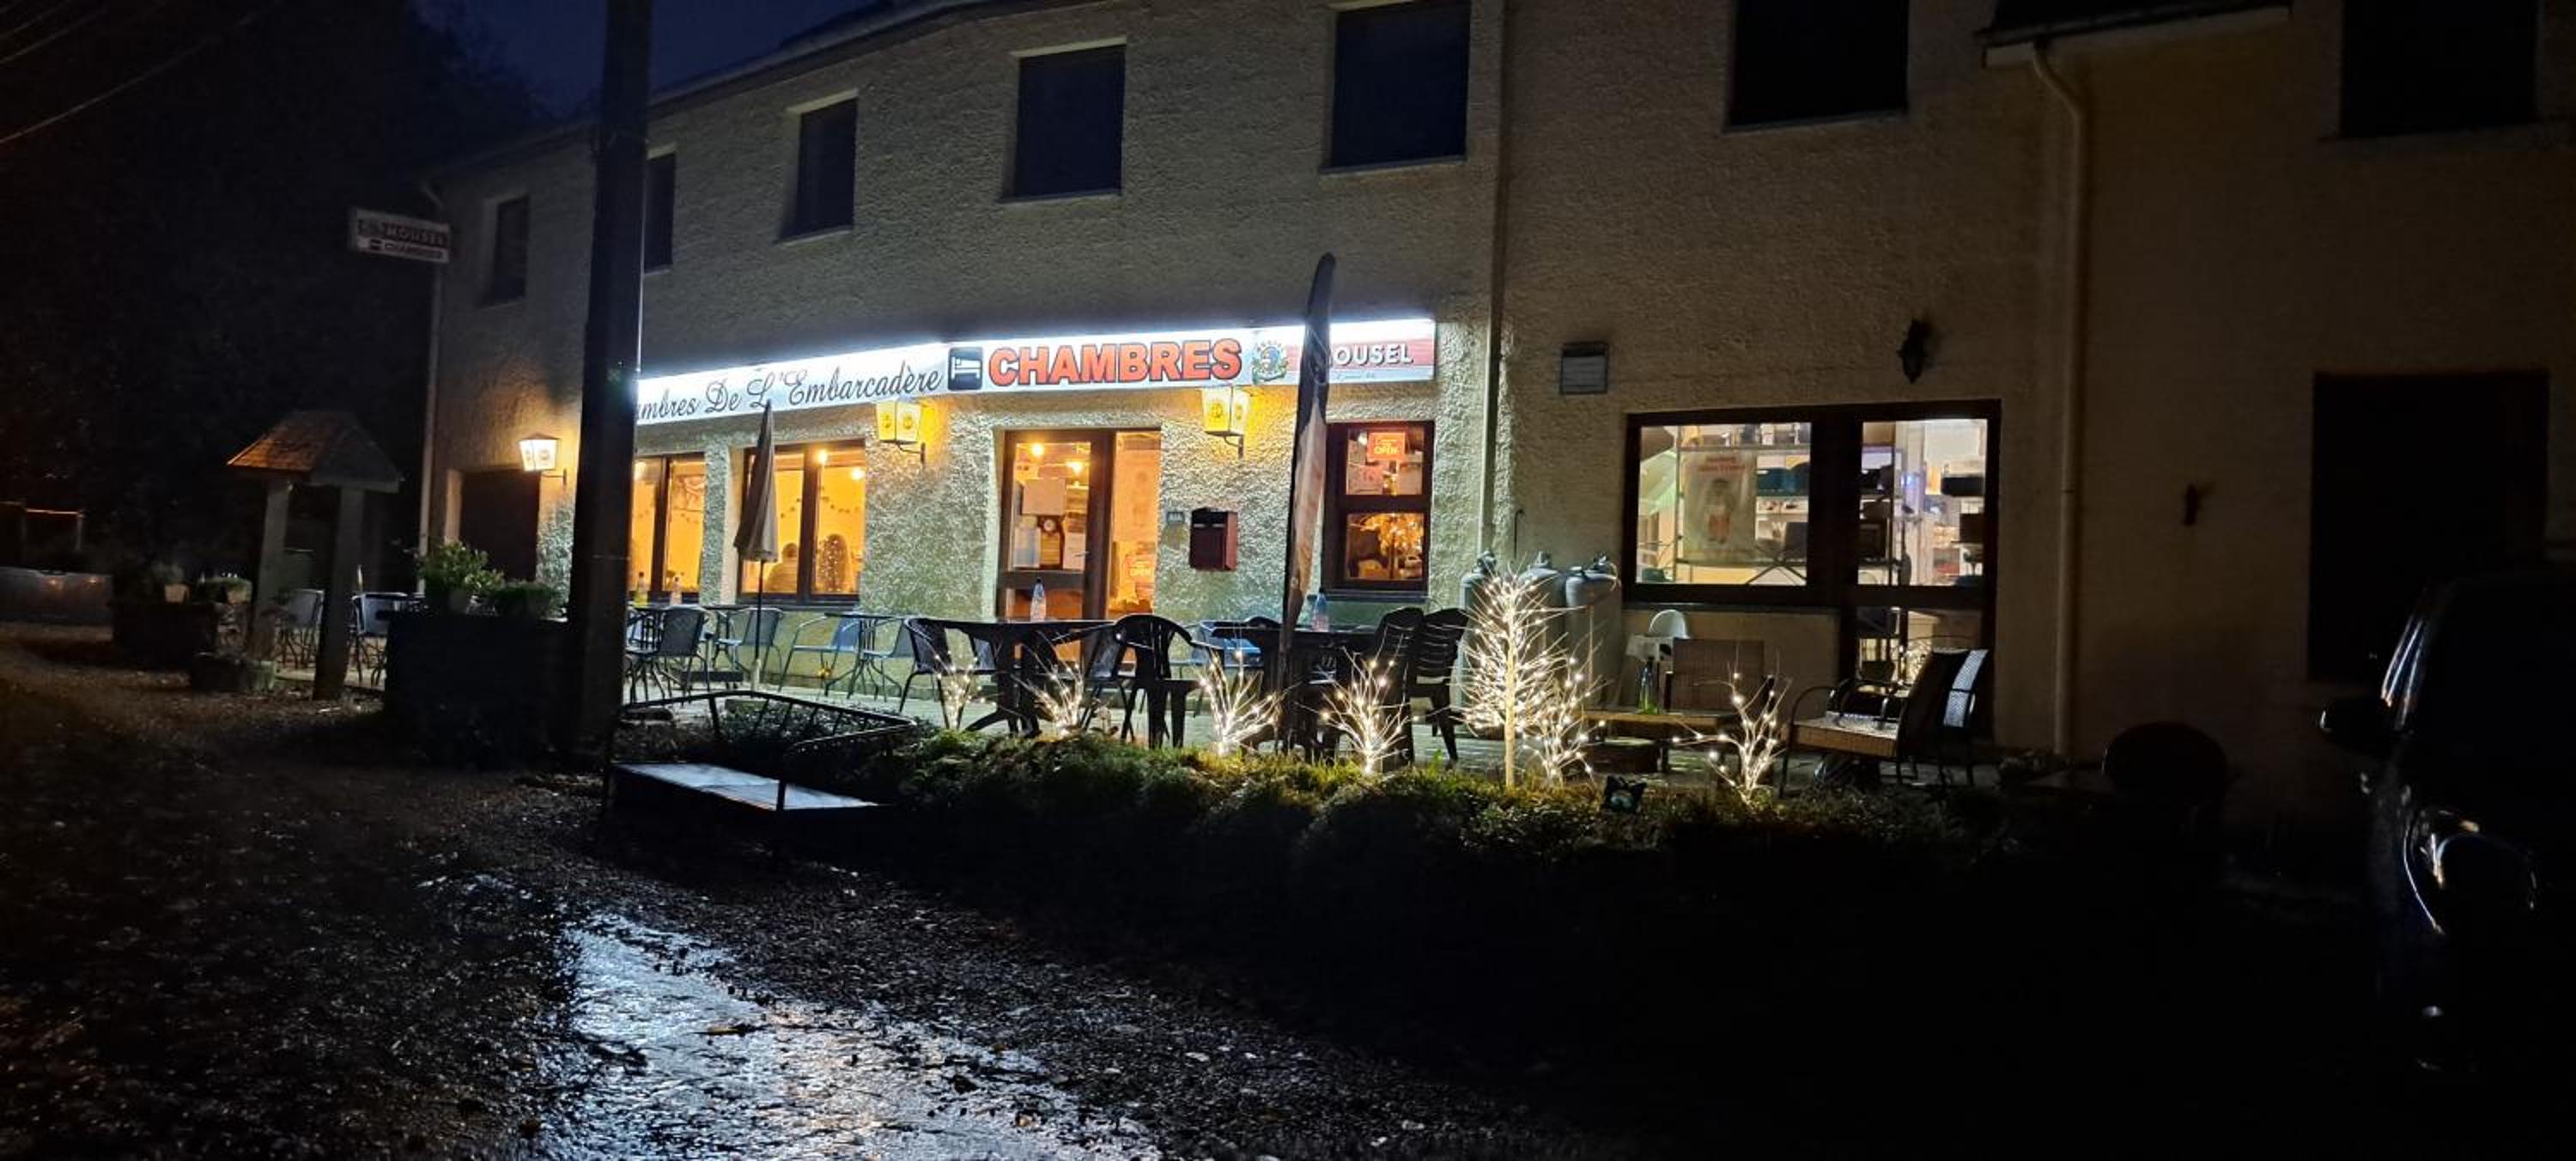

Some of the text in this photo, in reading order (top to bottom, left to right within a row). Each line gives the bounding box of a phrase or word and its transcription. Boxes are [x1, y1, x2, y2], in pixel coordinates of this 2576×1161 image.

[988, 339, 1242, 386] CHAMBRES
[1330, 343, 1413, 366] OUSEL
[705, 380, 739, 413] De
